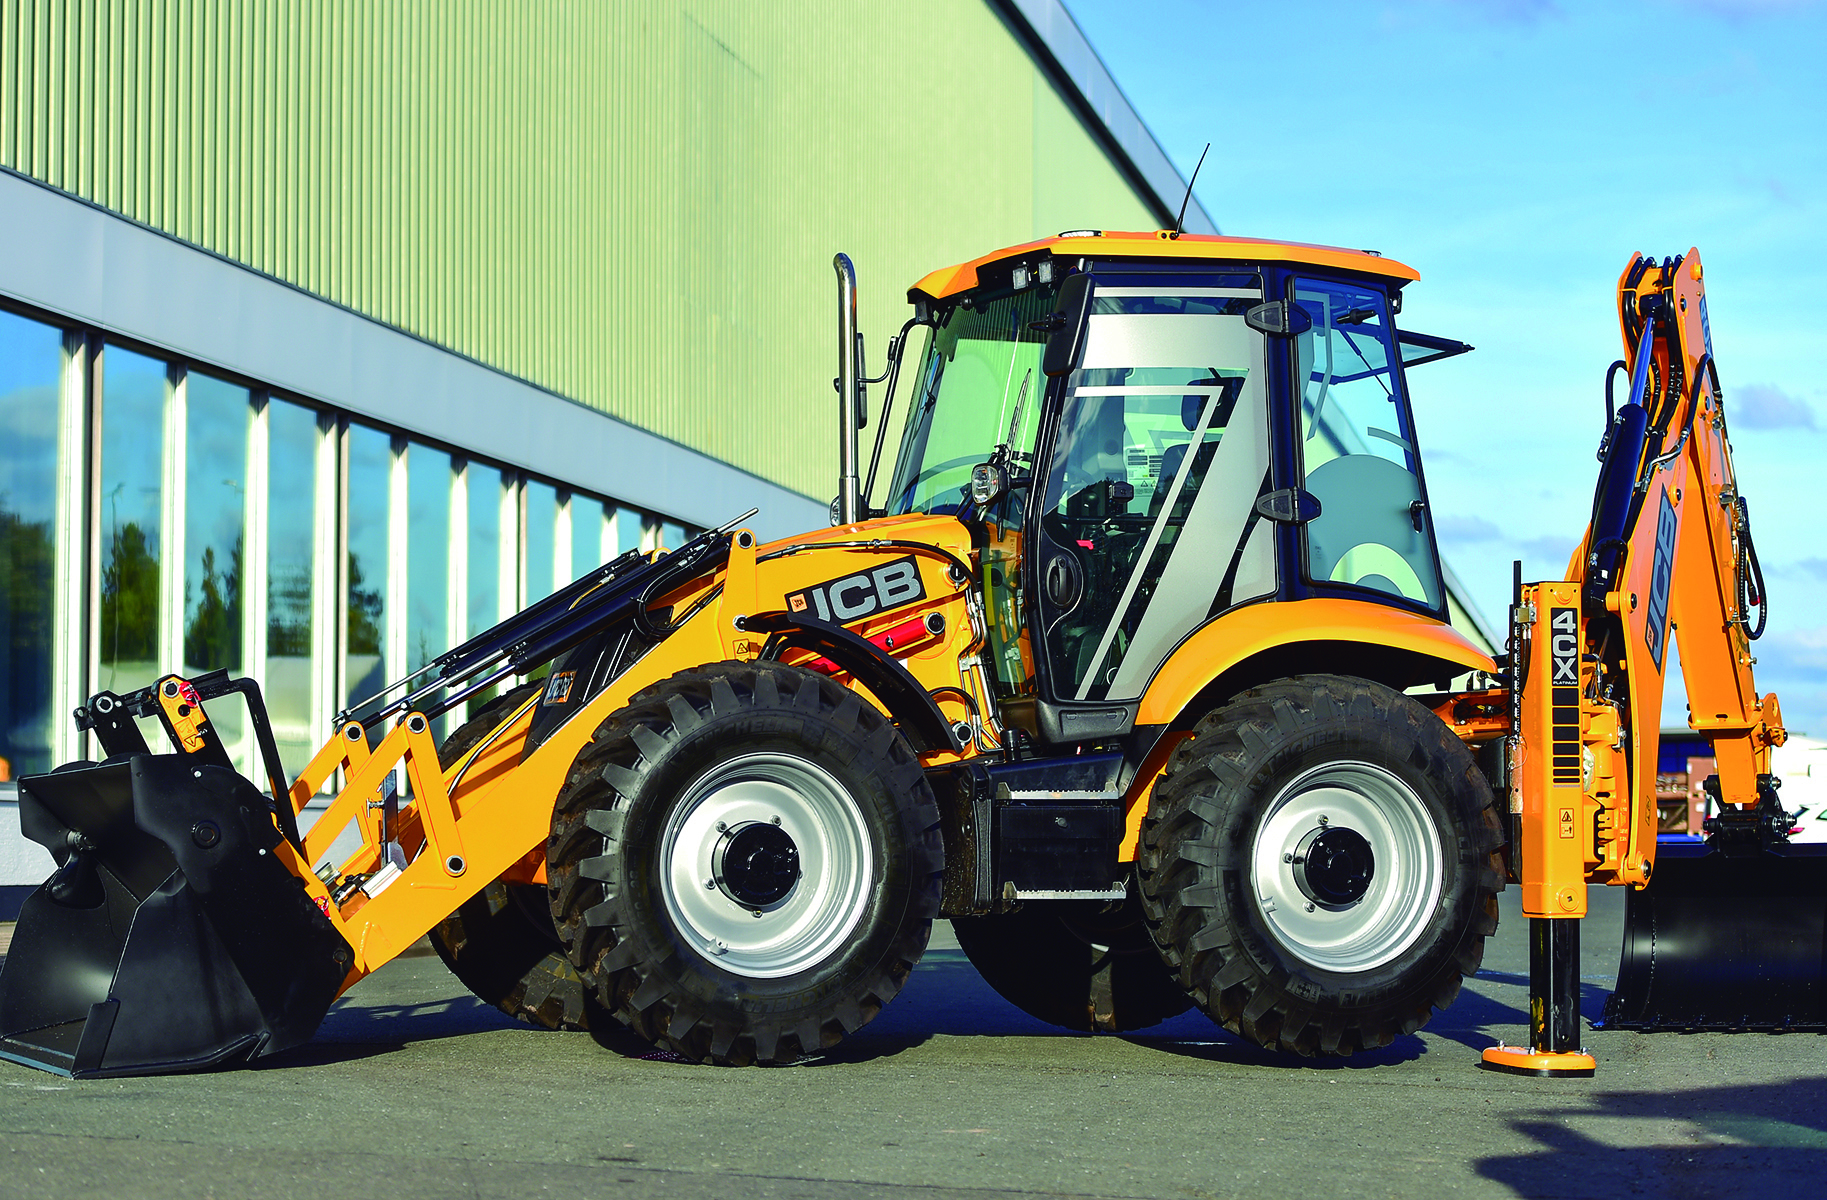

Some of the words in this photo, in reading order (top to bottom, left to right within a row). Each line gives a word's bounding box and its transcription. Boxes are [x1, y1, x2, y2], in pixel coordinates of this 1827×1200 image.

[812, 561, 921, 622] JCB
[1652, 496, 1677, 664] JCB
[1552, 611, 1577, 680] 4CX
